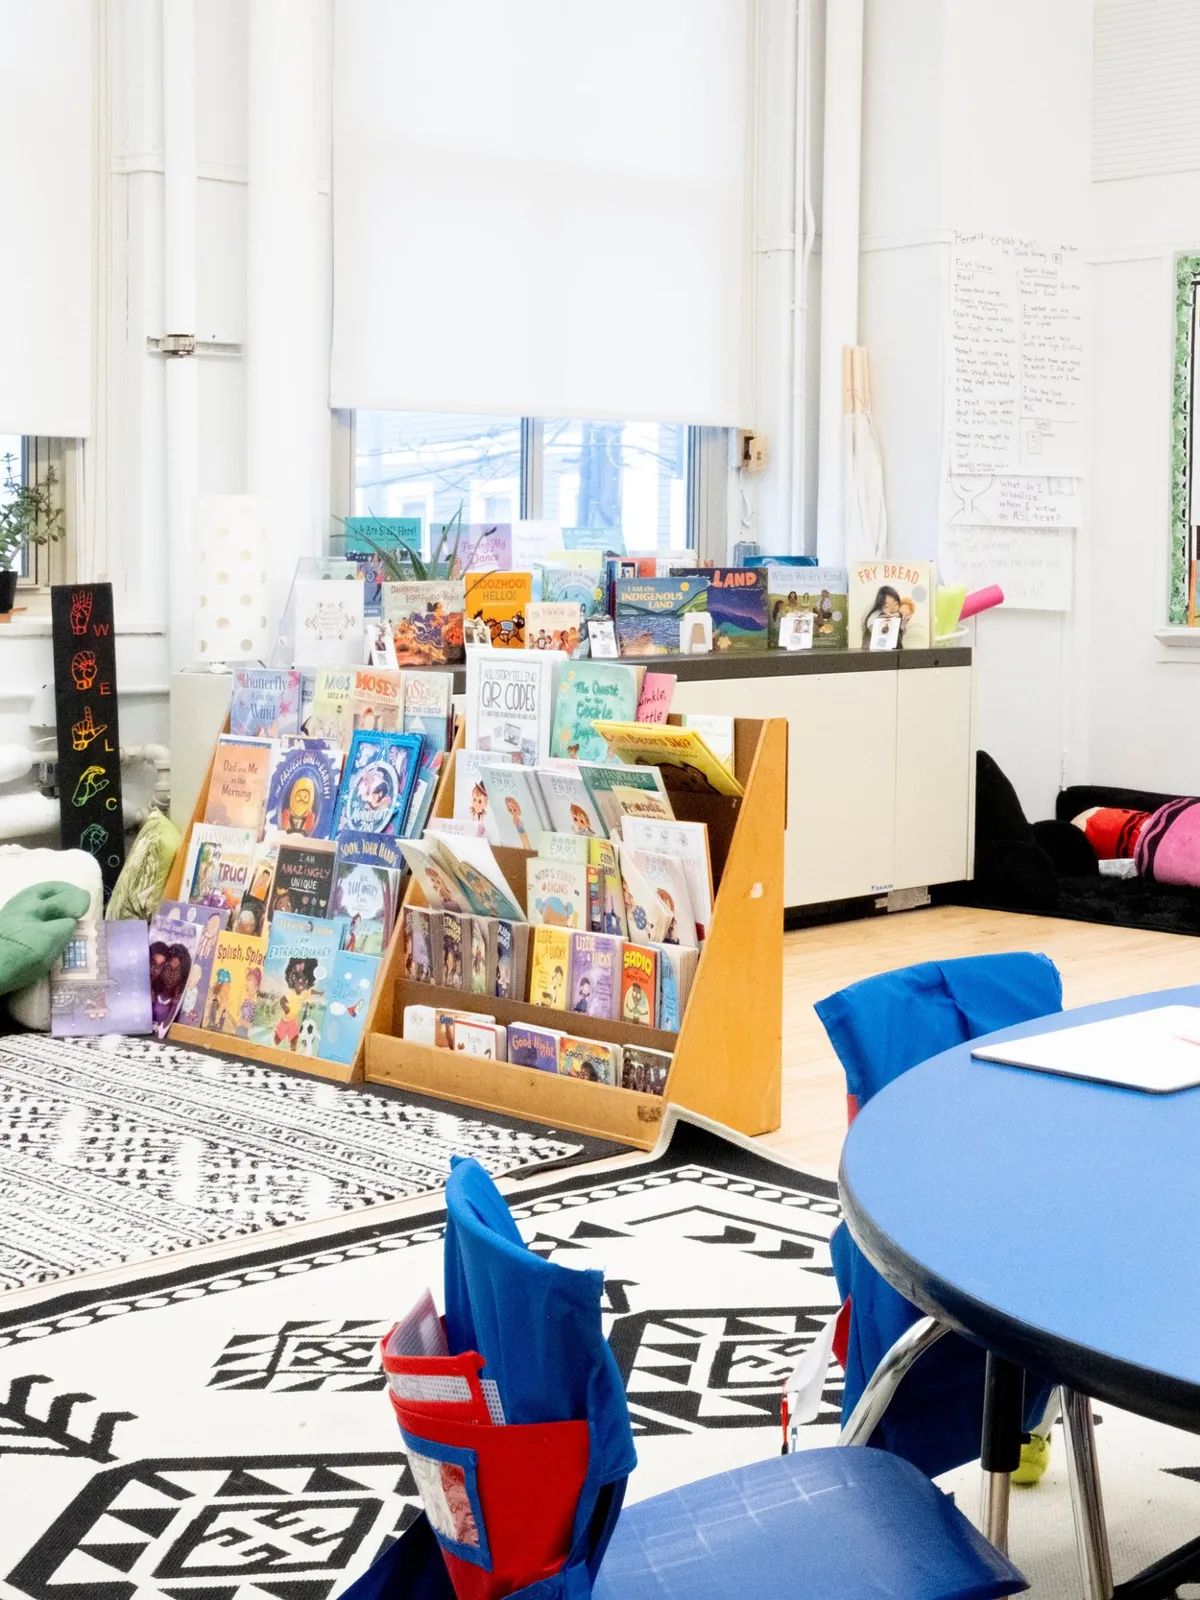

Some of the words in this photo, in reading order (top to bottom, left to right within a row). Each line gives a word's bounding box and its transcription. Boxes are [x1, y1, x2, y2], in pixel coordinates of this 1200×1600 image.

[1000, 480, 1020, 489] What
[1025, 483, 1033, 491] do
[1001, 490, 1039, 501] visualize
[999, 499, 1021, 509] when
[1035, 504, 1056, 513] view
[1013, 511, 1030, 521] ASL
[366, 526, 378, 536] Are
[398, 526, 417, 536] Here!
[492, 539, 507, 550] My
[468, 553, 500, 565] Dance
[713, 570, 757, 588] LAND
[772, 571, 793, 582] When
[795, 571, 807, 581] We
[808, 571, 821, 581] Are
[823, 571, 842, 582] Kind
[858, 566, 877, 585] FRY
[883, 564, 920, 585] BREAD
[483, 591, 516, 601] HELLO!
[621, 592, 684, 601] INDIGENOUS
[648, 601, 674, 609] LAND
[246, 673, 288, 690] Butterfly
[484, 668, 495, 680] ASL
[496, 669, 537, 682] STORYTELLING
[324, 675, 351, 690] MOS
[355, 671, 398, 697] MOSES
[592, 680, 619, 696] Quest
[481, 681, 502, 709] QR
[505, 682, 536, 712] CODES
[638, 686, 667, 707] winkle,
[251, 703, 276, 720] Wind
[631, 736, 665, 747] Bears
[667, 737, 692, 749] Ski?
[223, 760, 237, 772] Dad
[248, 762, 258, 774] Me
[237, 777, 246, 785] the
[600, 769, 650, 783] HANDMADE
[221, 785, 252, 802] Morning
[358, 821, 374, 832] ZOO
[305, 854, 315, 864] AM
[341, 841, 360, 857] SOON,
[362, 838, 378, 855] YOUR
[378, 842, 398, 868] HANDS
[535, 868, 555, 882] NITA'S
[557, 869, 576, 885] FIRST
[547, 882, 568, 895] SIGNS
[537, 928, 552, 944] LIZZIE
[550, 945, 566, 960] LUCKY
[217, 944, 245, 963] Splish,
[268, 945, 332, 960] EXTRAORDINARY
[576, 935, 596, 951] LIZZIE
[592, 952, 613, 968] LUCKY
[512, 1032, 532, 1050] Good
